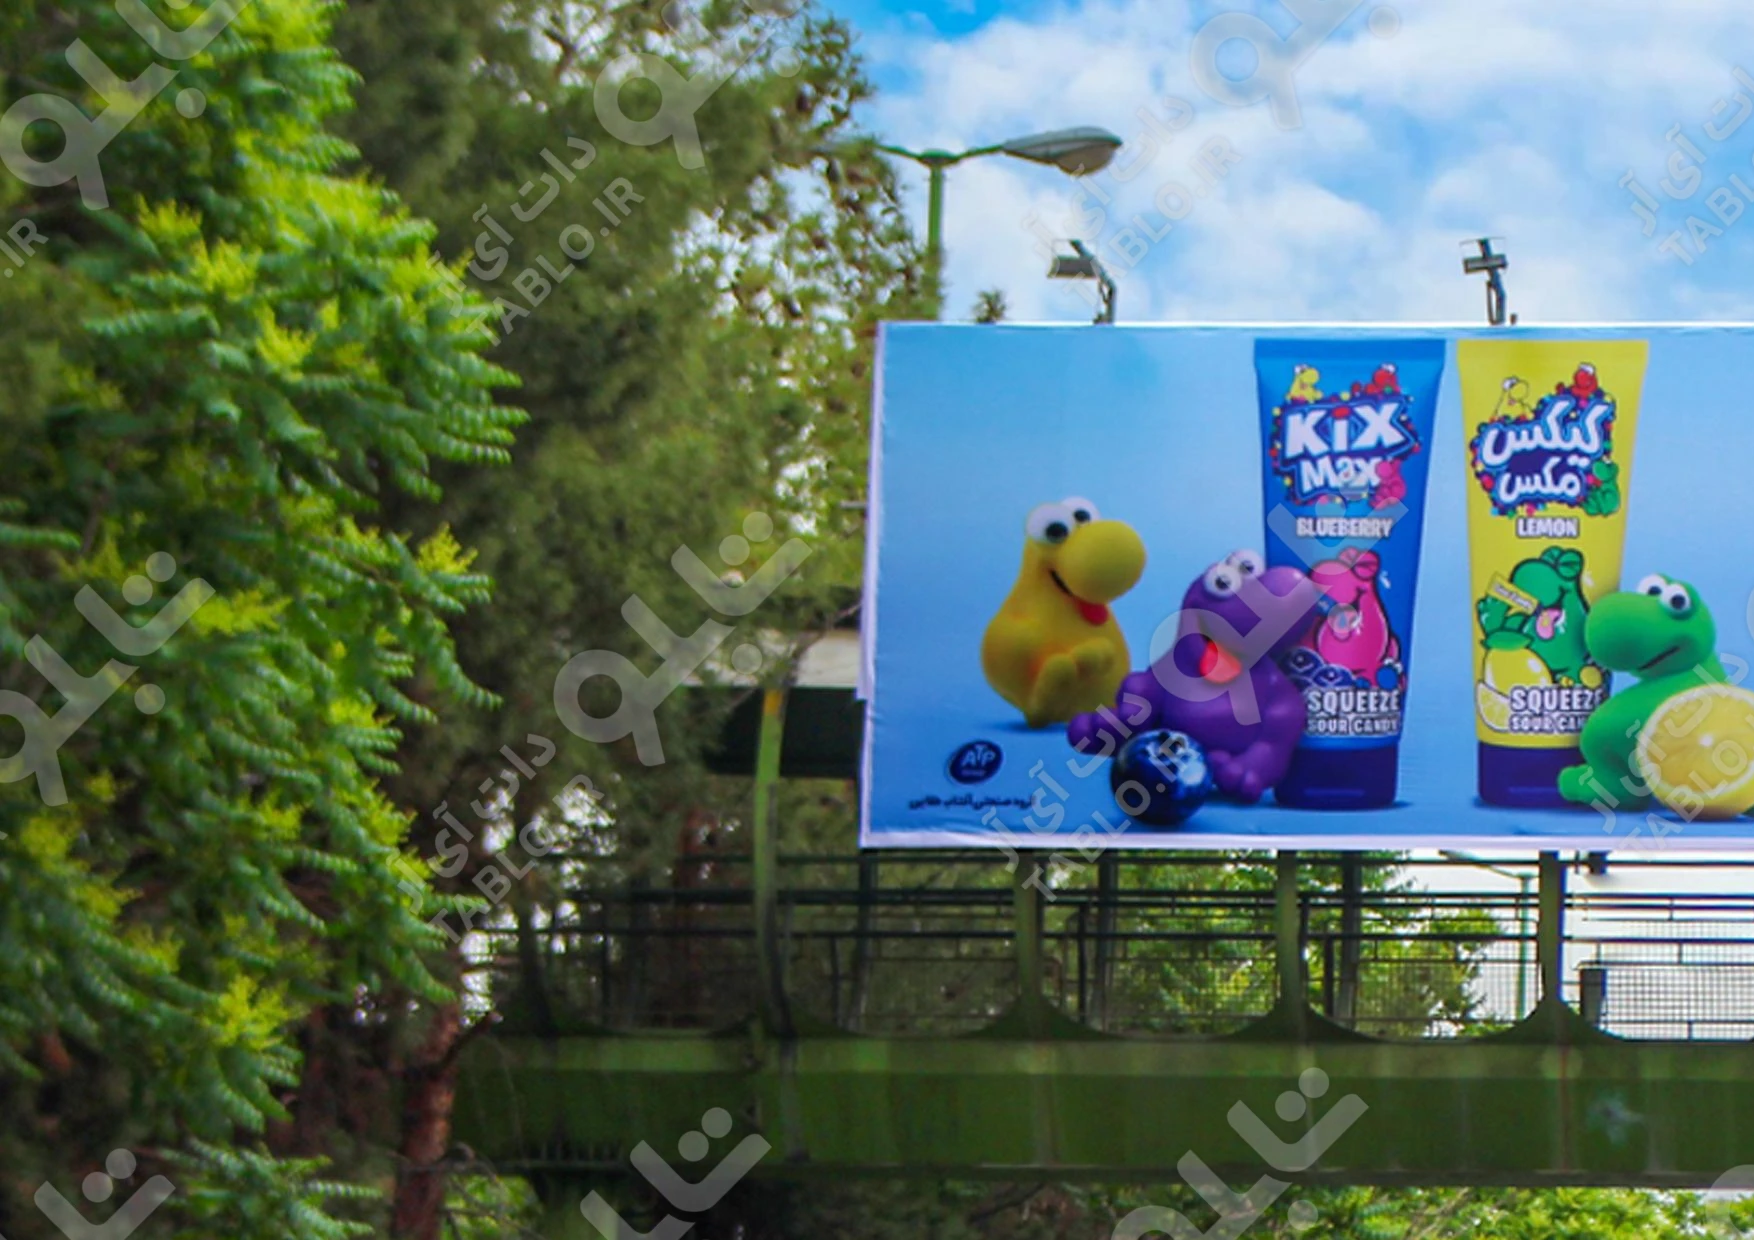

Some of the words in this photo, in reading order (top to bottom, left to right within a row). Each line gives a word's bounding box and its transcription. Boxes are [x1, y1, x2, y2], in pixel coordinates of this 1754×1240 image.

[1482, 400, 1608, 467] کیکس
[1500, 456, 1581, 503] مکس
[1297, 517, 1392, 537] BLUEBERRY
[1517, 517, 1578, 537] LEMON
[1307, 690, 1399, 715] SQUEEZE
[1308, 718, 1348, 733] SOUR
[1353, 718, 1398, 733] CANDY
[1510, 716, 1553, 731] SOUR
